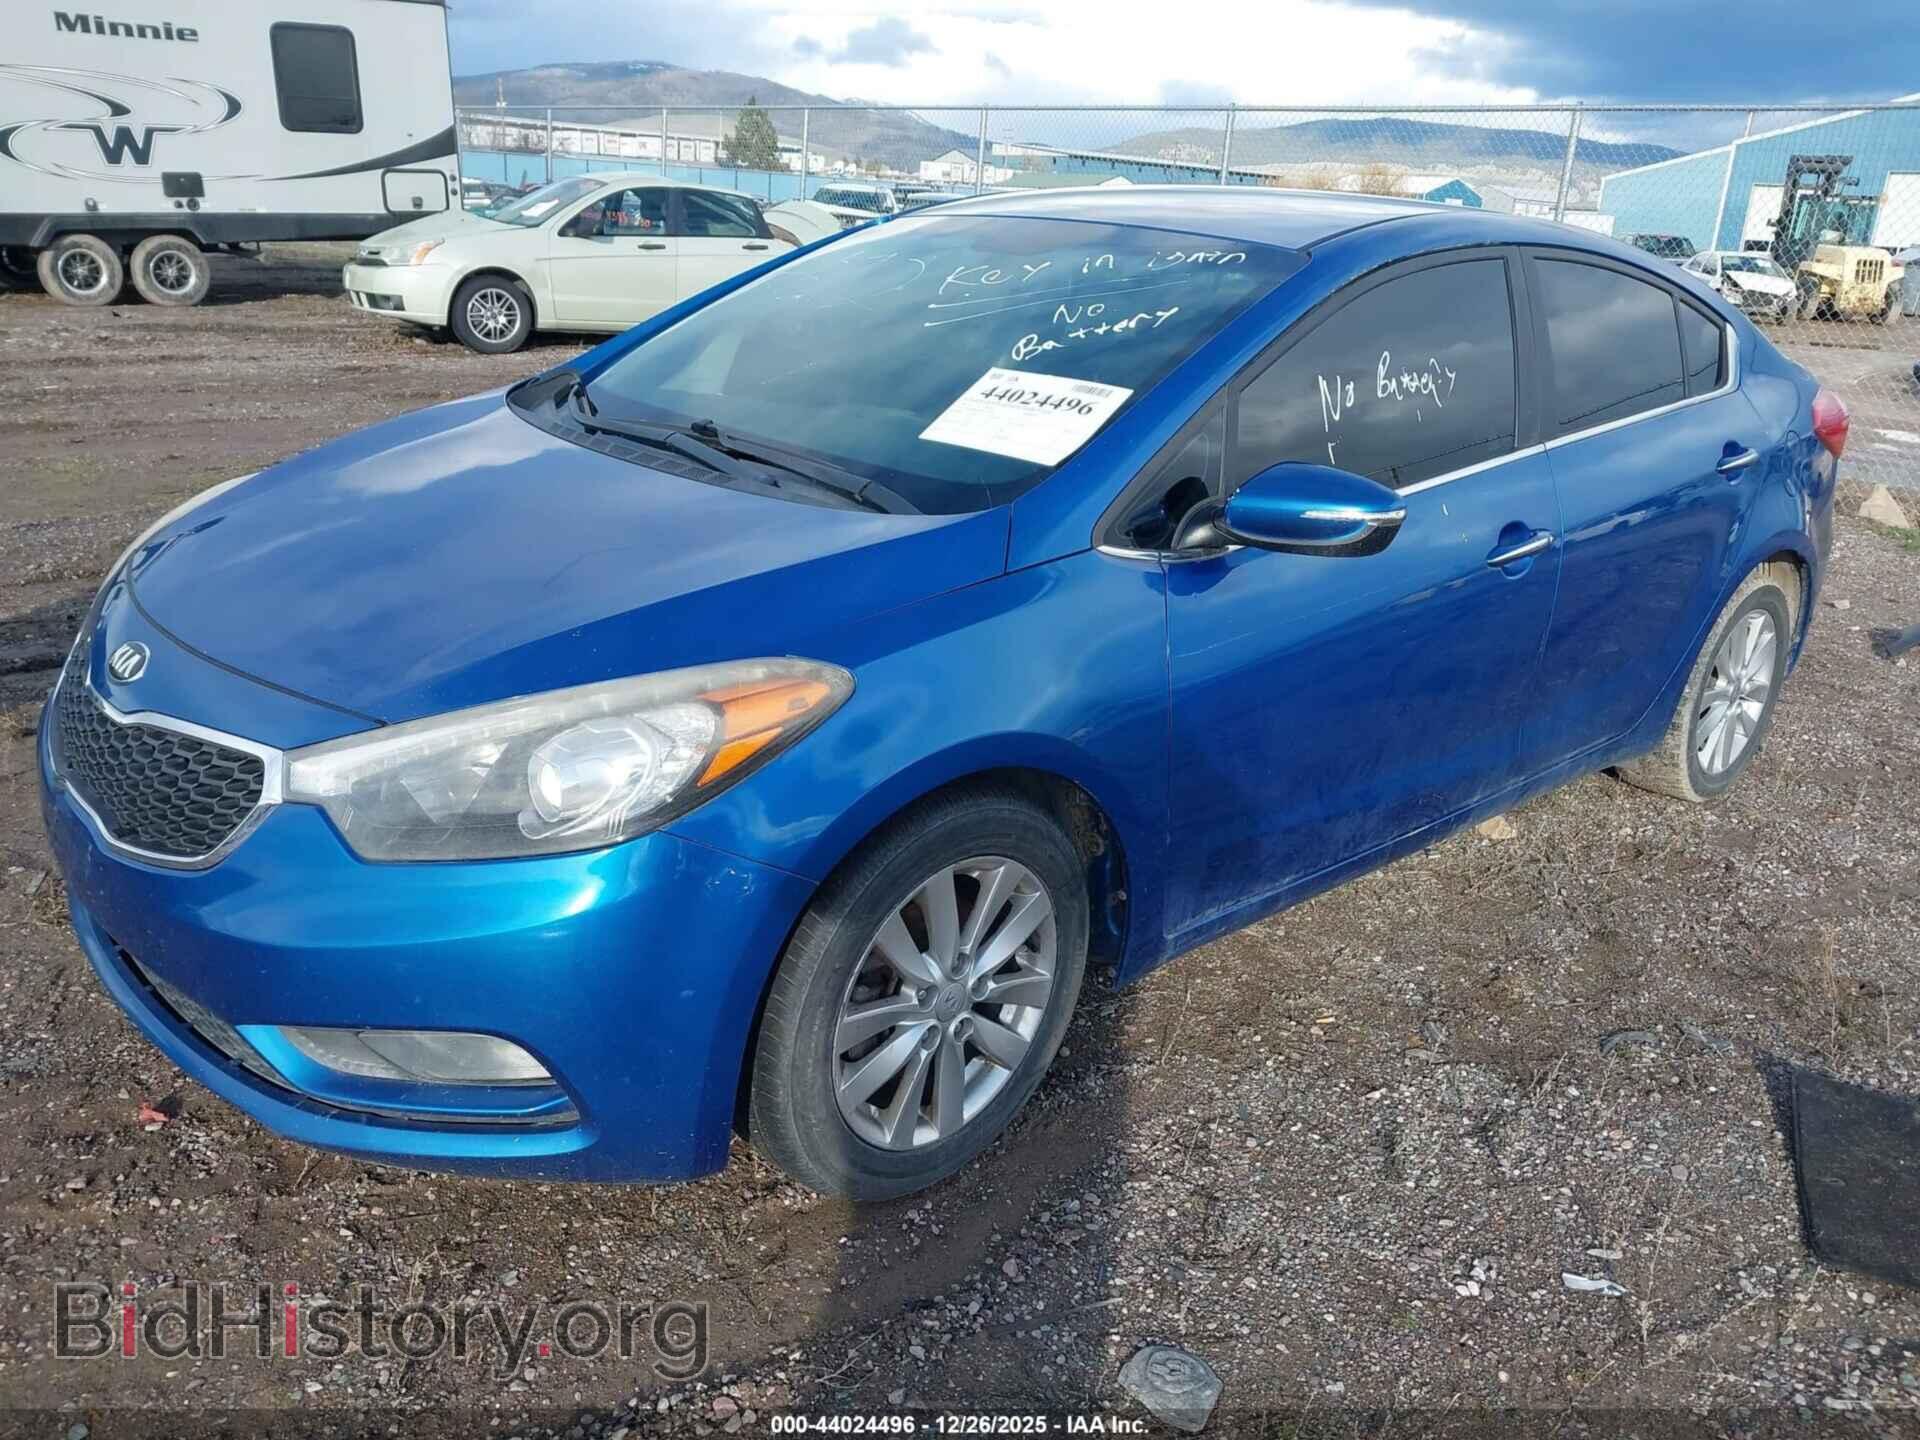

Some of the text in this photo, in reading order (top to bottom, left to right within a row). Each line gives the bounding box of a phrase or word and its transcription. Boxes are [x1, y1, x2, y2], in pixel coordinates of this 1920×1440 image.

[53, 11, 199, 43] Minnie
[1082, 253, 1115, 274] in
[1011, 306, 1180, 361] Battery
[980, 385, 1095, 416] 44024496
